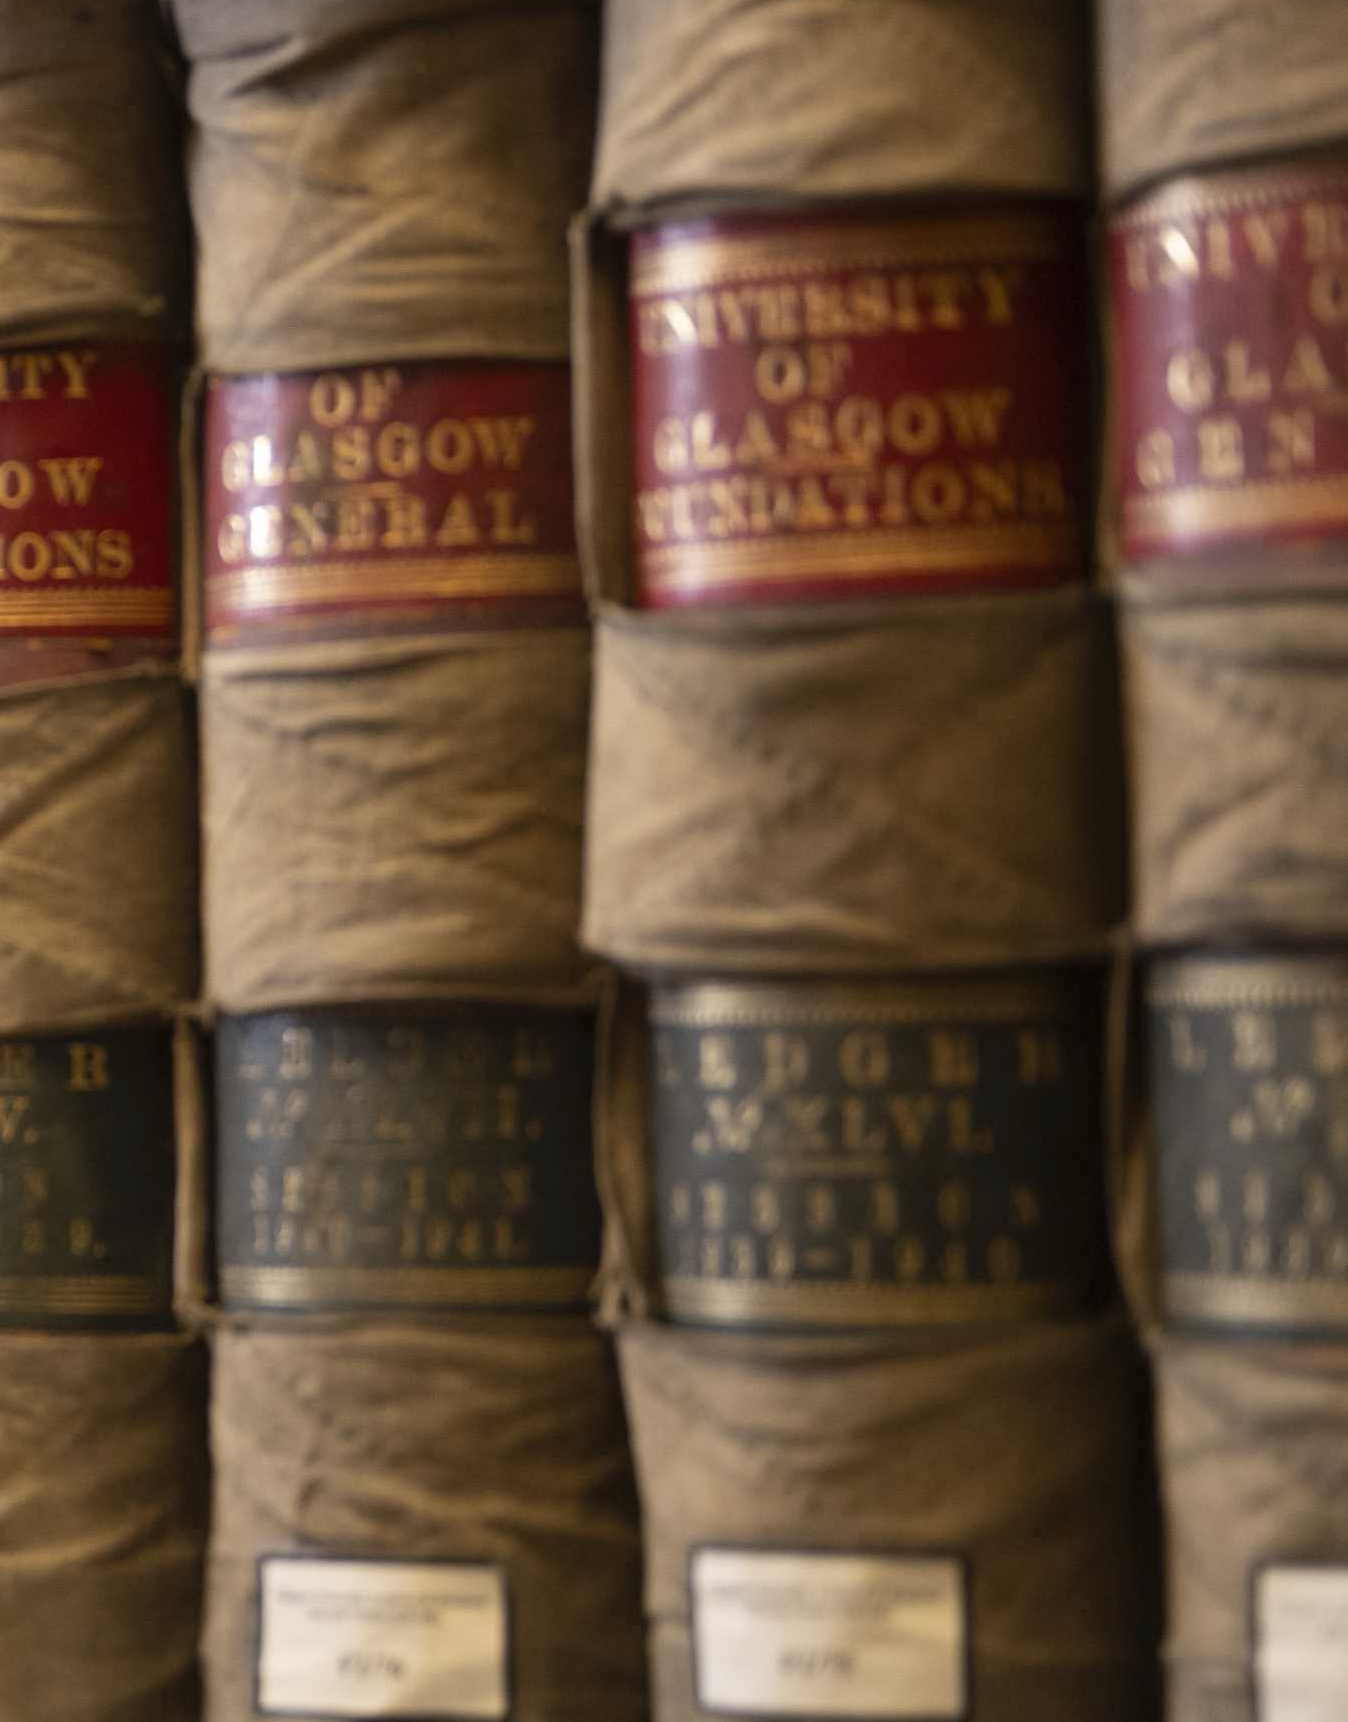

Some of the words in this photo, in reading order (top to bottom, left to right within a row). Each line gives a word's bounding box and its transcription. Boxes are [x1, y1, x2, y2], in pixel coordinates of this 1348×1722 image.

[756, 341, 854, 403] OF
[221, 415, 539, 493] GLASGOW
[653, 388, 1014, 474] GLASGOW
[218, 489, 538, 564] GENERAL
